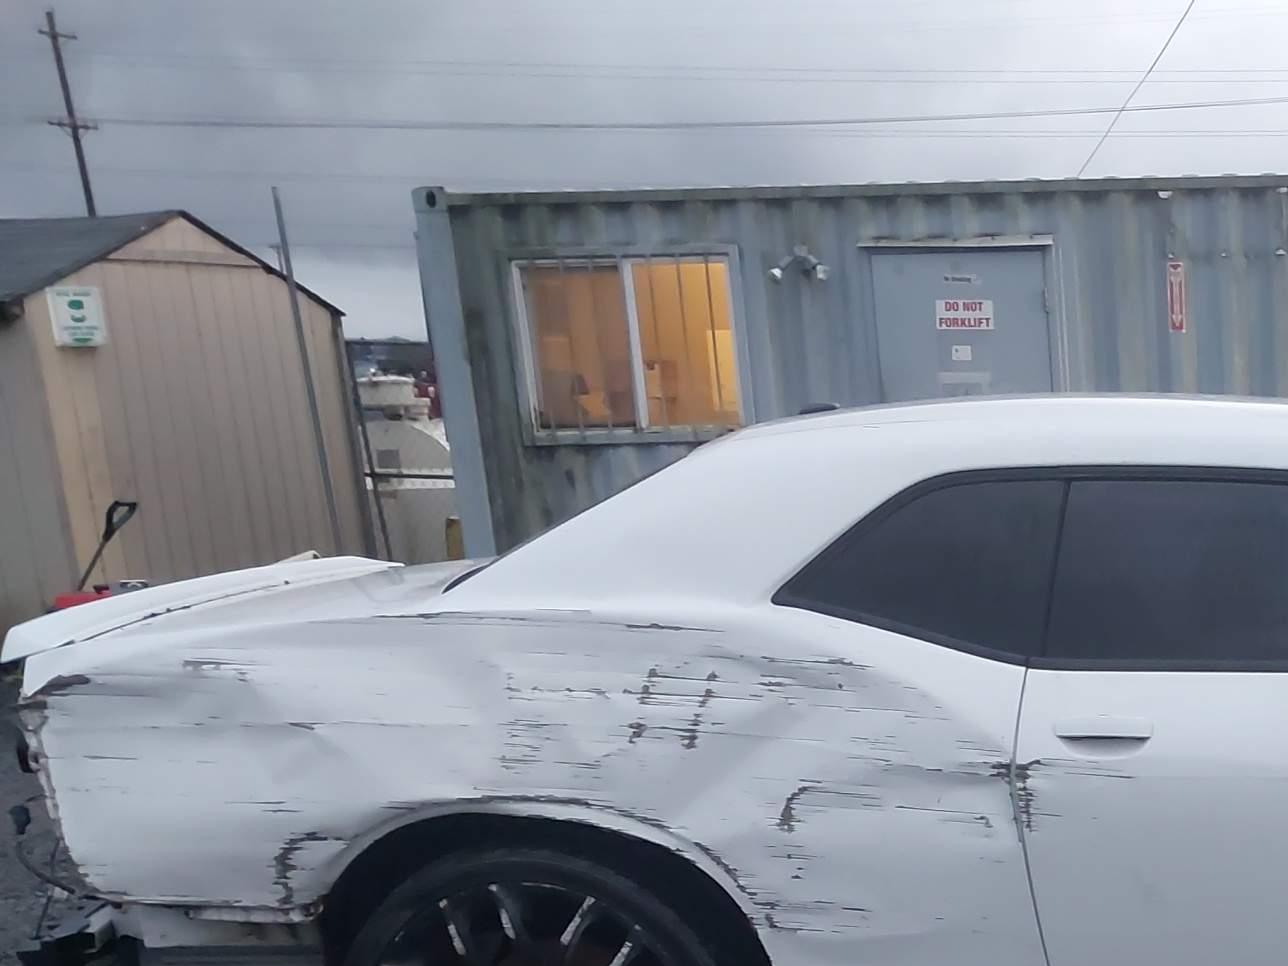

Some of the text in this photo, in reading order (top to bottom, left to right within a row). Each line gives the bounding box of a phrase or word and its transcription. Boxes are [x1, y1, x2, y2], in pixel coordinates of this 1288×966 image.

[944, 301, 984, 312] DO NOT
[938, 317, 991, 328] FORKLIFT
